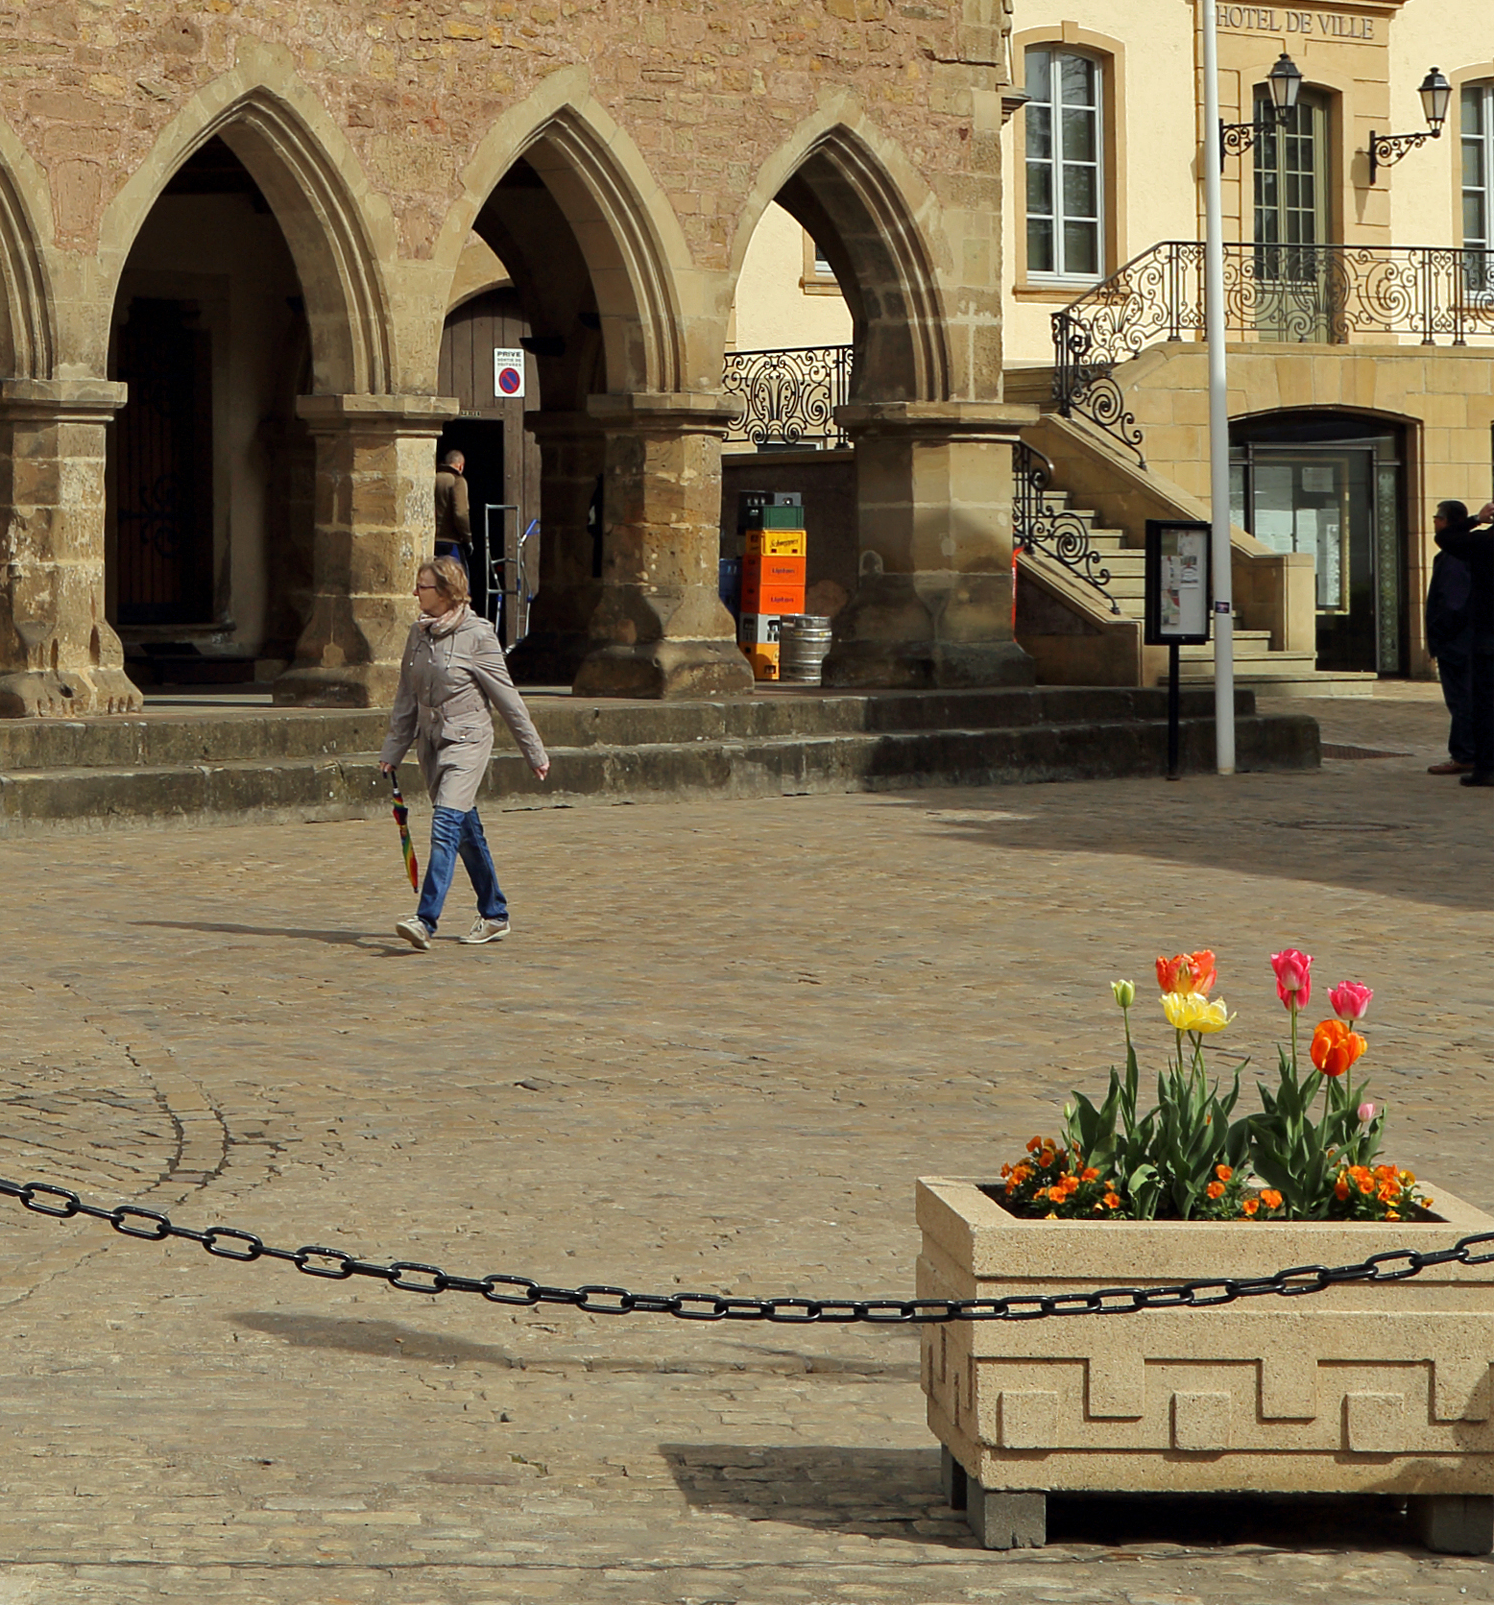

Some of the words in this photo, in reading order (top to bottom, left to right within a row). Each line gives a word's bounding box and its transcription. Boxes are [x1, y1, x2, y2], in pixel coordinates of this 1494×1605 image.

[1216, 4, 1282, 32] HOTEL
[1286, 10, 1313, 34] DE
[1317, 13, 1374, 40] VILLE
